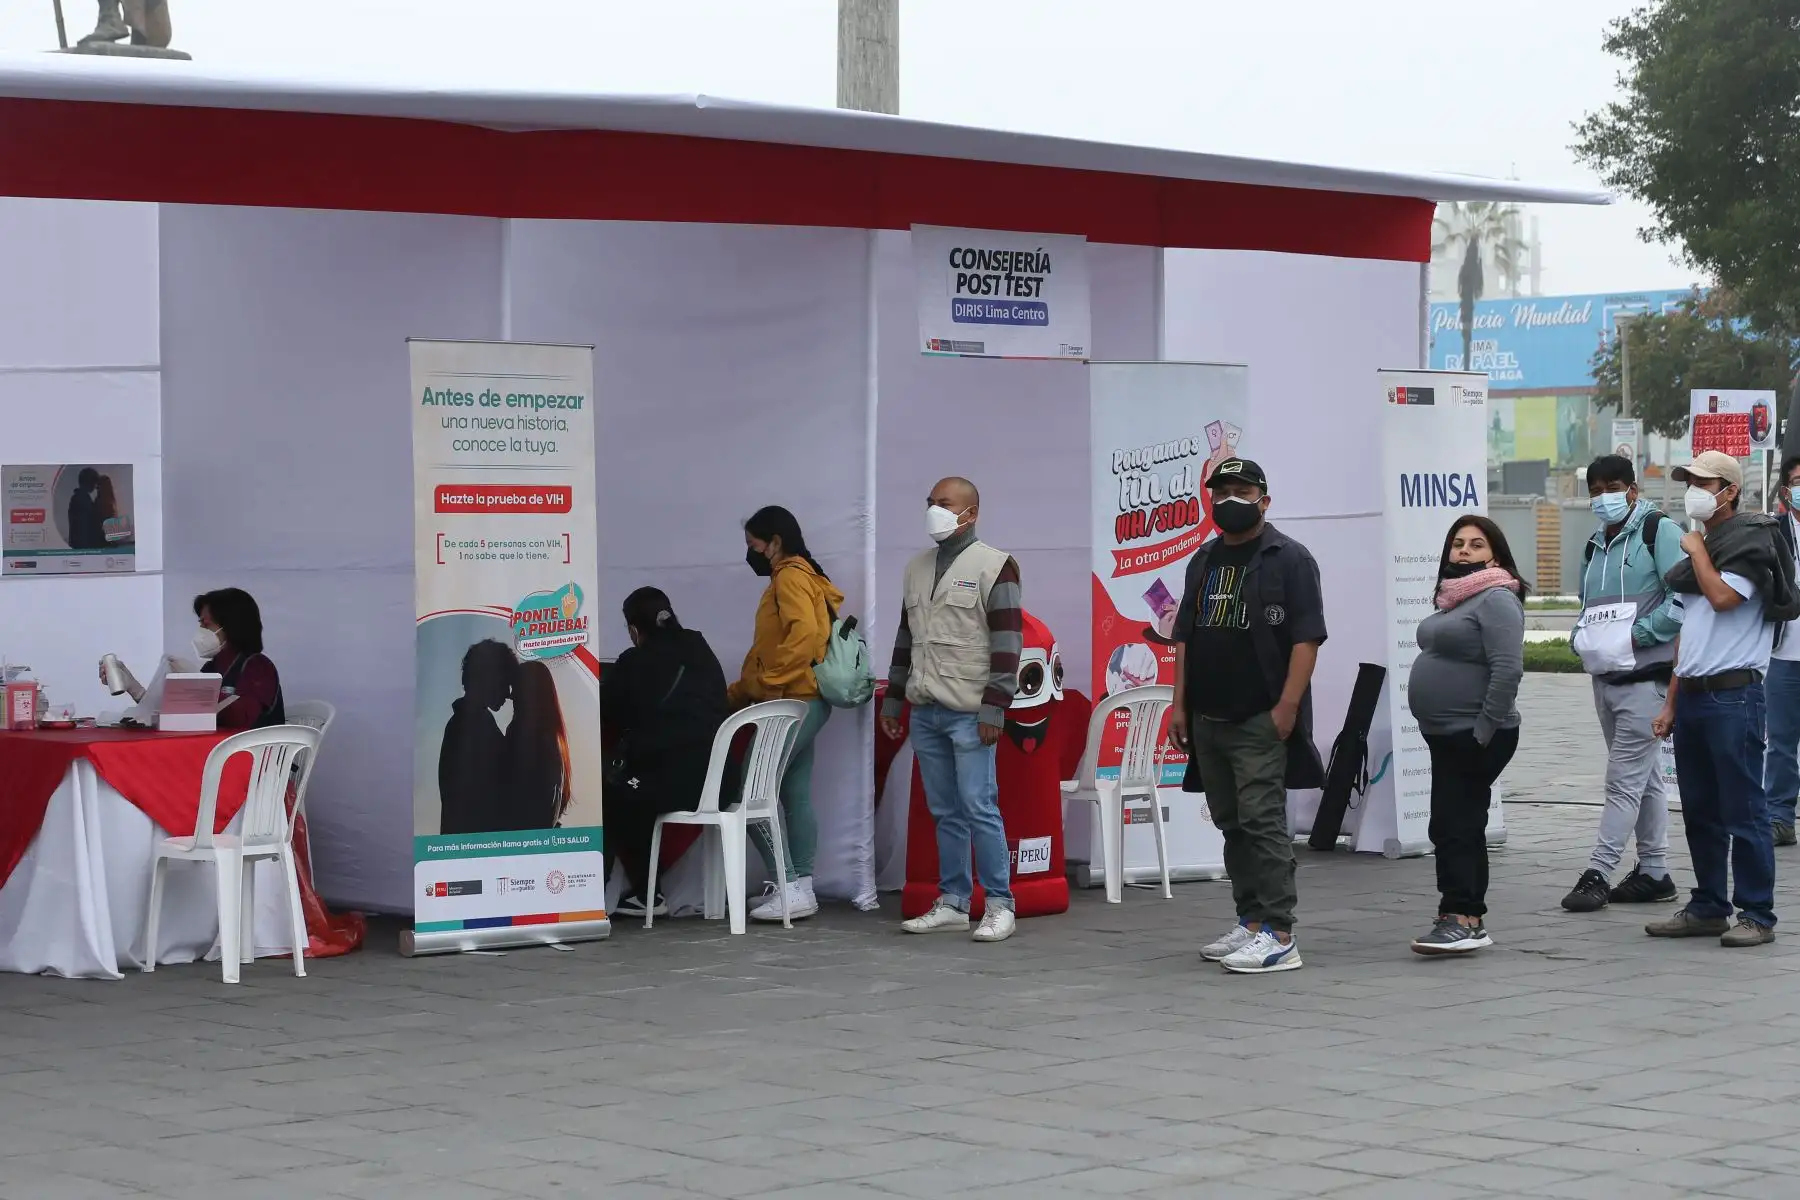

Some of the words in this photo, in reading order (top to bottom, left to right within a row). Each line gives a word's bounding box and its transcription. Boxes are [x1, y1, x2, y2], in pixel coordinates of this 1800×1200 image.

[950, 247, 1052, 275] CONSEJERÍA
[956, 272, 1001, 295] POST
[1004, 274, 1044, 297] TEST
[955, 303, 983, 318] DIRIS
[985, 305, 1010, 319] Lima
[1012, 306, 1046, 321] Centro
[1510, 300, 1592, 330] Mundial
[421, 387, 474, 407] Antes
[479, 389, 501, 408] de
[505, 393, 585, 412] empezar
[441, 415, 468, 429] una
[471, 416, 515, 430] nueva
[517, 415, 569, 432] historia,
[452, 438, 507, 451] conoce
[510, 437, 522, 452] la
[524, 439, 559, 455] tuya.
[1119, 471, 1164, 512] Fin
[1168, 464, 1194, 498] al
[1400, 473, 1479, 507] MINSA
[441, 493, 474, 504] Hazte
[476, 493, 485, 504] la
[487, 493, 527, 507] prueba
[530, 494, 543, 504] de
[546, 494, 564, 505] VIH
[1115, 496, 1200, 544] VIH/SIDA
[444, 540, 456, 548] De
[458, 540, 479, 548] cada
[480, 540, 486, 548] 5
[488, 541, 527, 550] personas
[1135, 550, 1160, 566] otra
[1161, 533, 1201, 561] pandemia
[459, 552, 463, 560] 1
[475, 552, 497, 560] sabe
[499, 553, 515, 562] que
[516, 552, 523, 560] lo
[520, 628, 526, 636] A
[529, 616, 588, 636] PRUEBA!
[1114, 711, 1131, 719] Haz
[427, 844, 444, 853] Para
[445, 843, 460, 851] más
[461, 841, 502, 851] información
[503, 839, 522, 848] llama
[523, 838, 542, 848] gratis
[543, 837, 550, 845] al
[557, 837, 566, 845] 113
[567, 836, 590, 844] SALUD
[1020, 842, 1049, 863] PERÚ
[510, 878, 536, 887] Siempre
